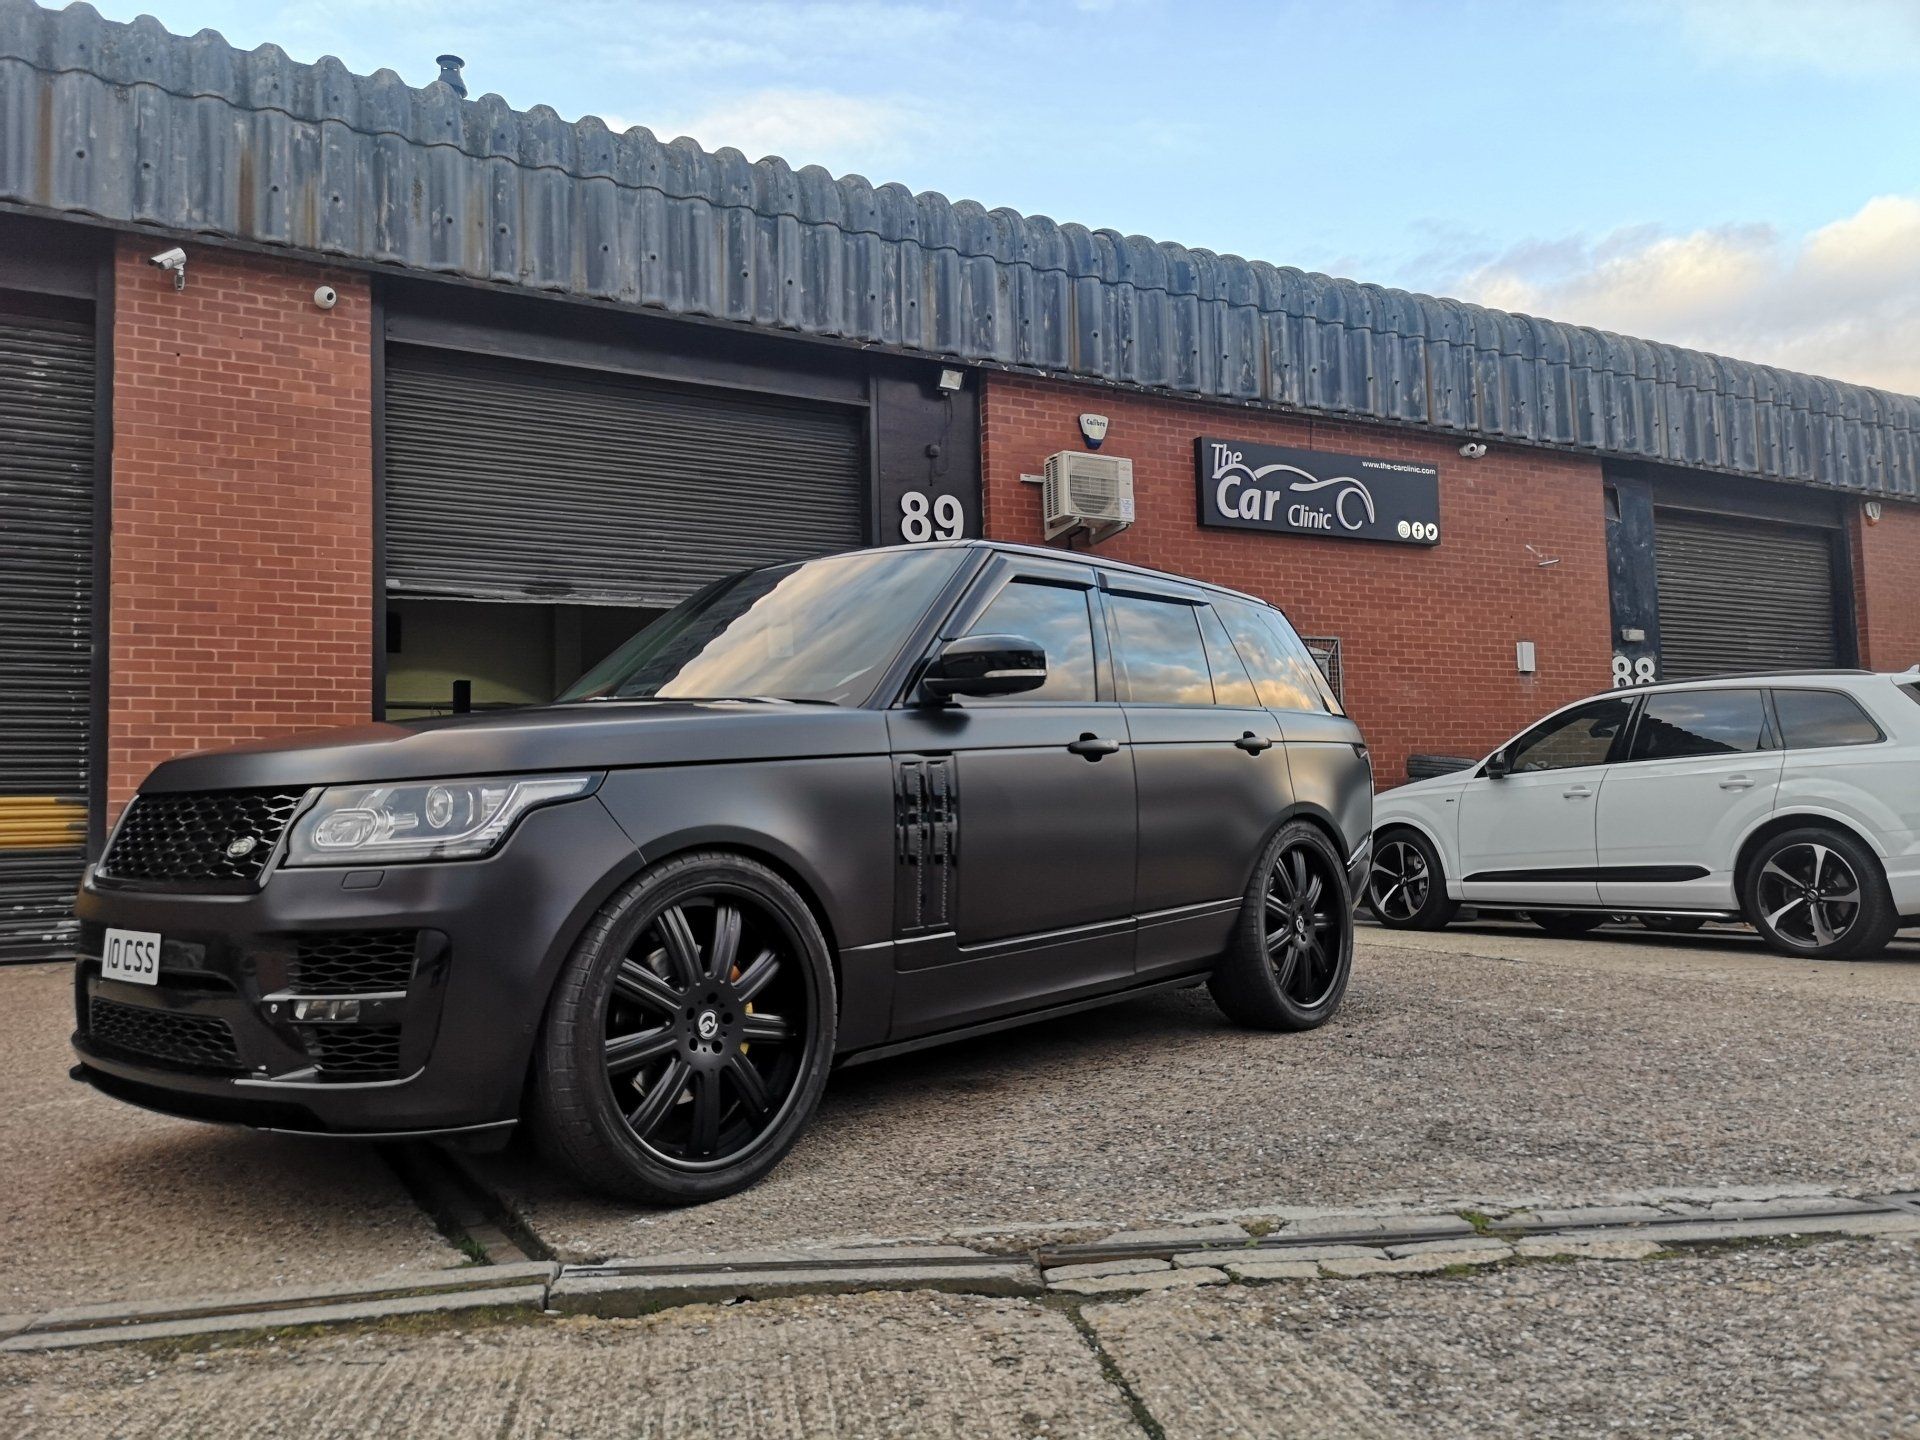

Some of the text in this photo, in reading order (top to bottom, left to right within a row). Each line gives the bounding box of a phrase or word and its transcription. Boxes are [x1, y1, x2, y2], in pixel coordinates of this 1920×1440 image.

[1210, 443, 1243, 479] The
[1362, 460, 1436, 475] www.the-carclinic.com
[901, 491, 964, 543] 89
[1216, 475, 1332, 530] Car Clinic
[1612, 655, 1656, 689] 88
[123, 939, 155, 974] CSS
